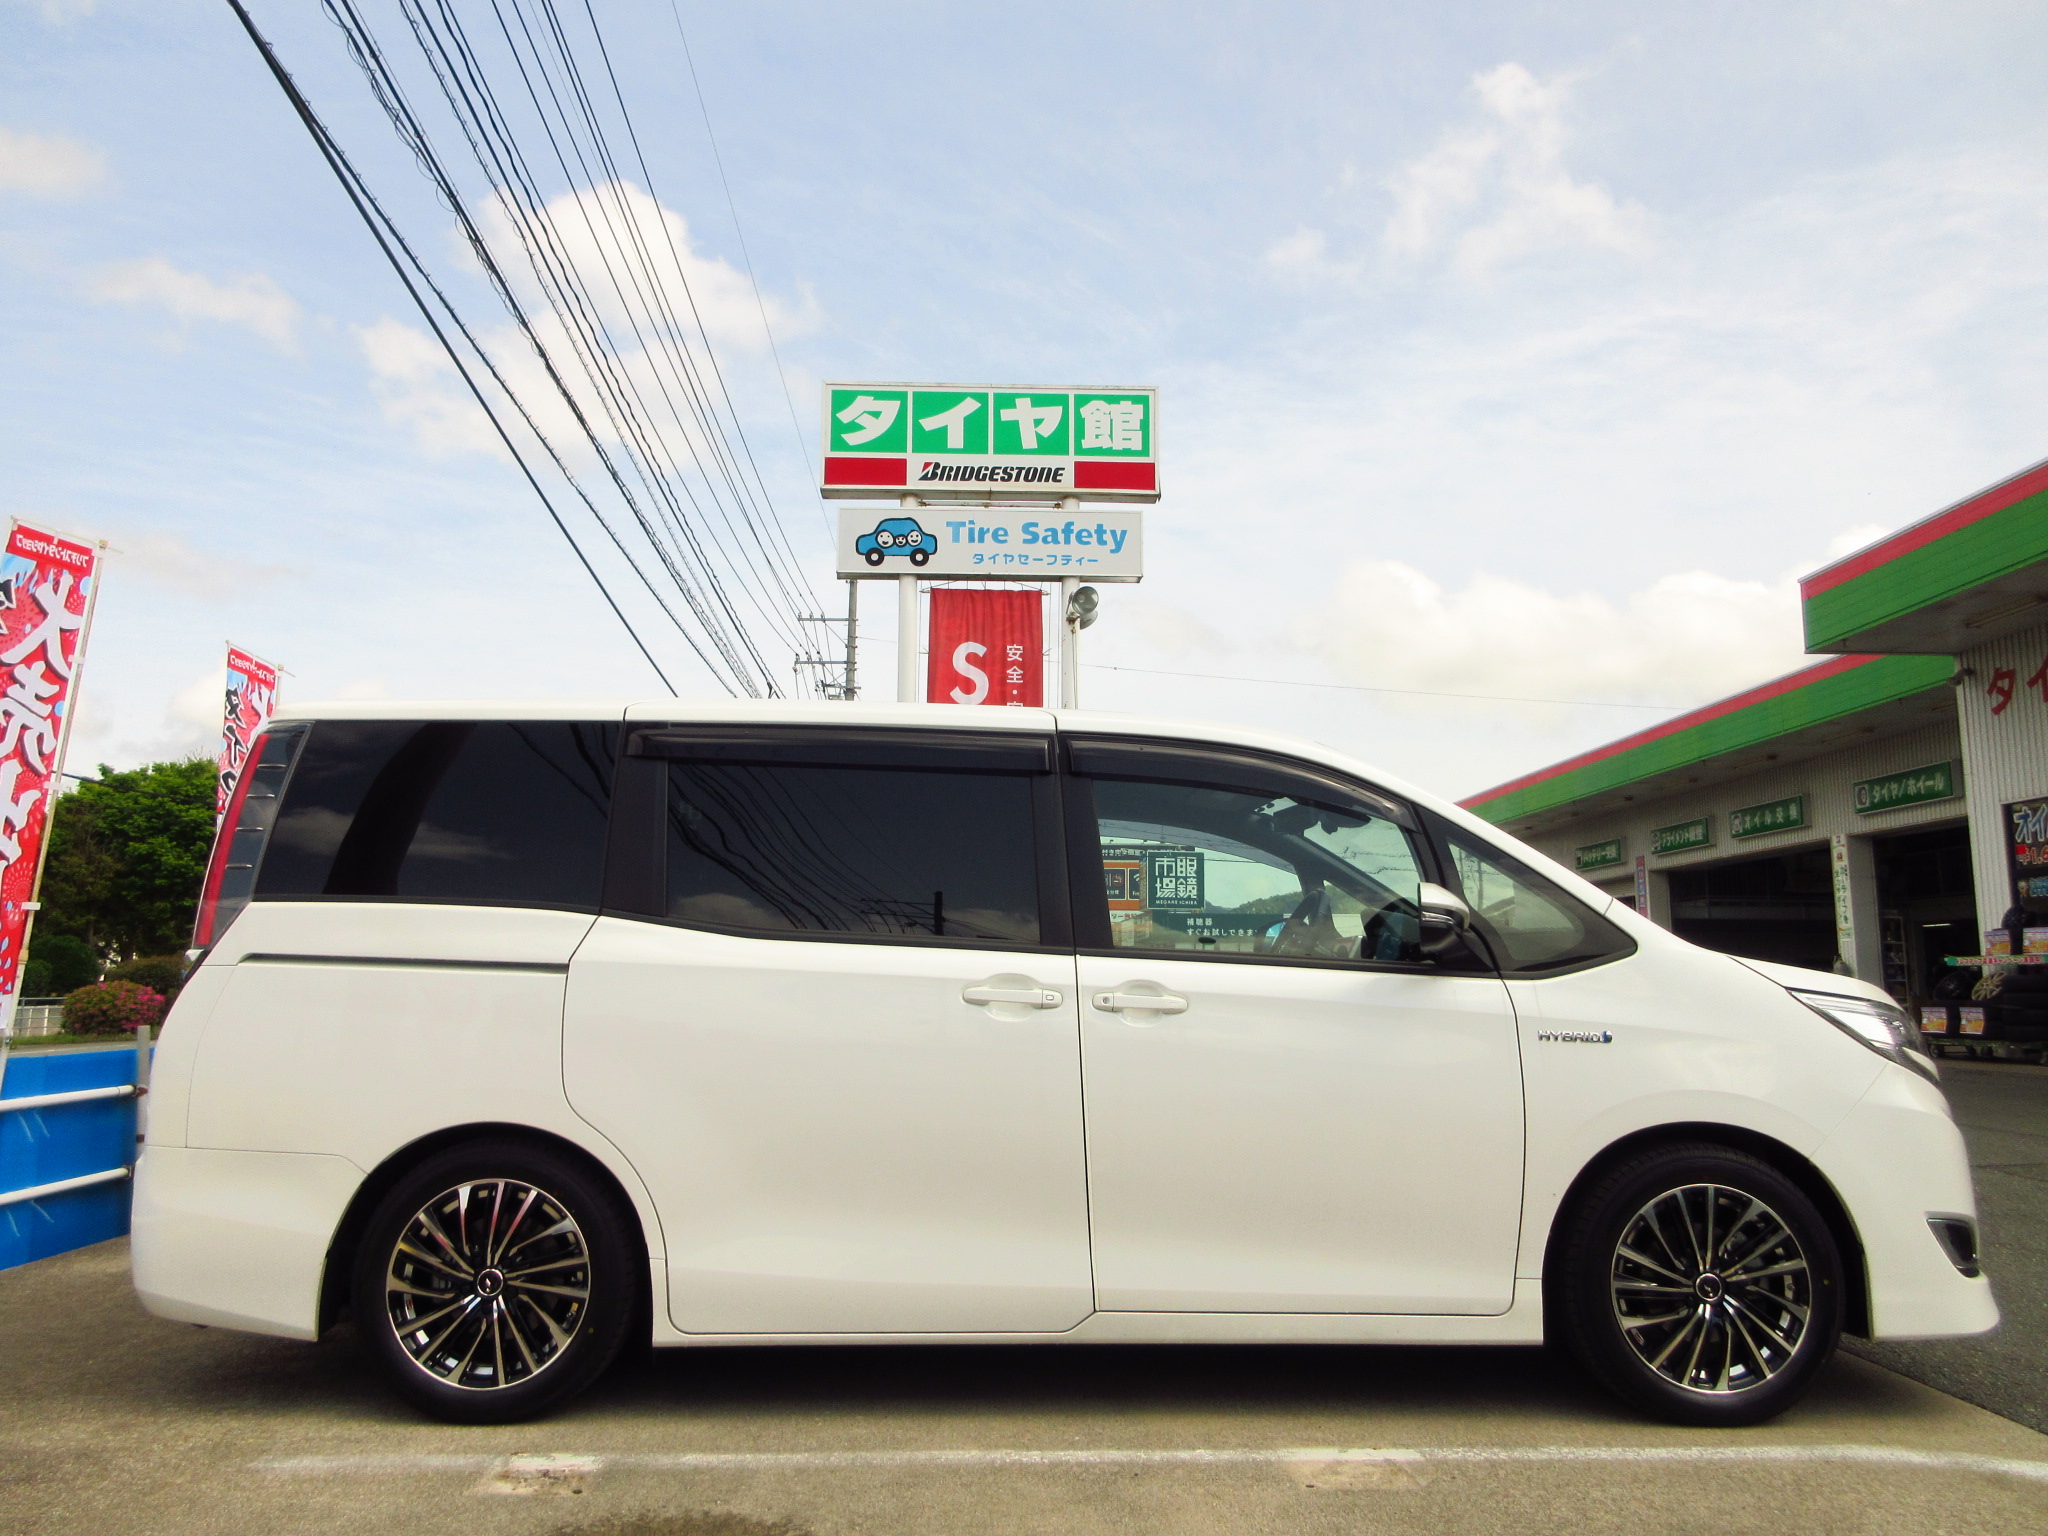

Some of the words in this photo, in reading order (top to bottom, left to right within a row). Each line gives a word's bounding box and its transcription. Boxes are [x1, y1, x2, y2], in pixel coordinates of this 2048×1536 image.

[836, 395, 1144, 451] タイヤ館
[918, 461, 1066, 484] BRIDGESTONE
[946, 520, 1009, 545] Tire
[1021, 520, 1128, 554] Safety
[972, 553, 1099, 566] タイヤセーフティー
[950, 641, 990, 704] S
[2013, 803, 2048, 844] オイ
[1187, 918, 1213, 926] 補聴器
[1187, 928, 1258, 937] すぐお試しできま
[1538, 1030, 1601, 1043] HYBRID
